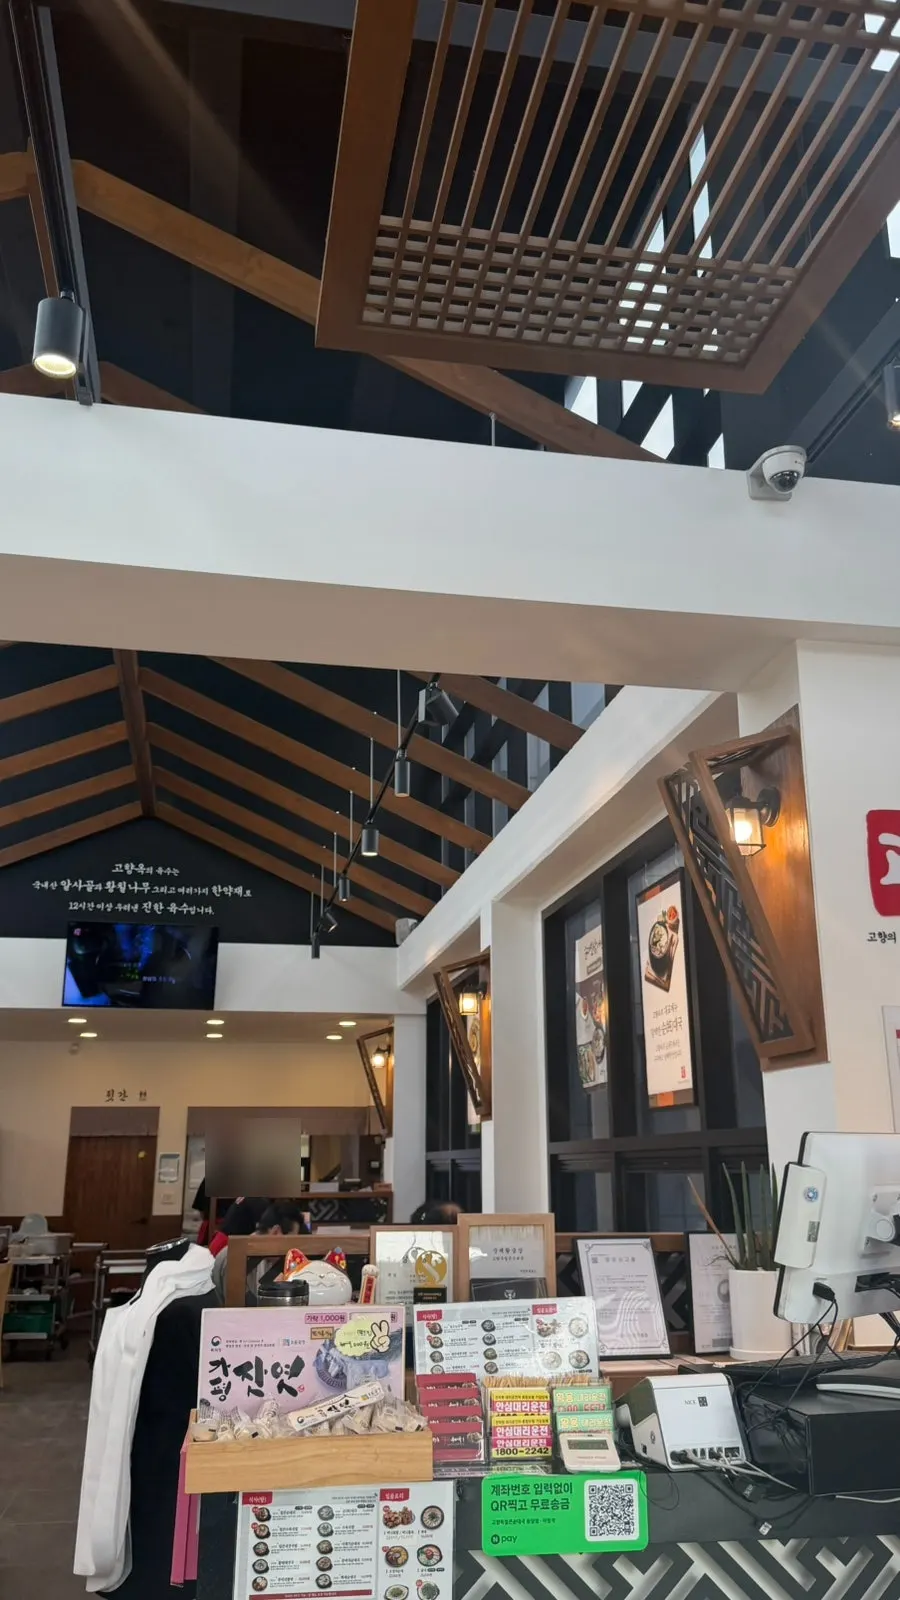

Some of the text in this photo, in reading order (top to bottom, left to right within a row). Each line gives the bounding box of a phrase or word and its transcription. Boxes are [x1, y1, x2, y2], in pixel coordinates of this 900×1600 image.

[32, 880, 58, 890] 국내산
[152, 885, 176, 894] 그리고
[68, 901, 95, 911] 12시간
[96, 902, 113, 912] 이상
[142, 901, 164, 914] 진한
[867, 931, 897, 944] 고향의
[495, 1401, 548, 1412] 안심대리운전
[495, 1425, 549, 1437] 안심대리운전
[495, 1438, 547, 1448] 안심대리운전
[495, 1447, 549, 1455] 1800-2242
[490, 1482, 573, 1497] 계좌번호 입력없이
[490, 1498, 570, 1512] QR찍고 무료송금
[501, 1535, 518, 1544] pay
